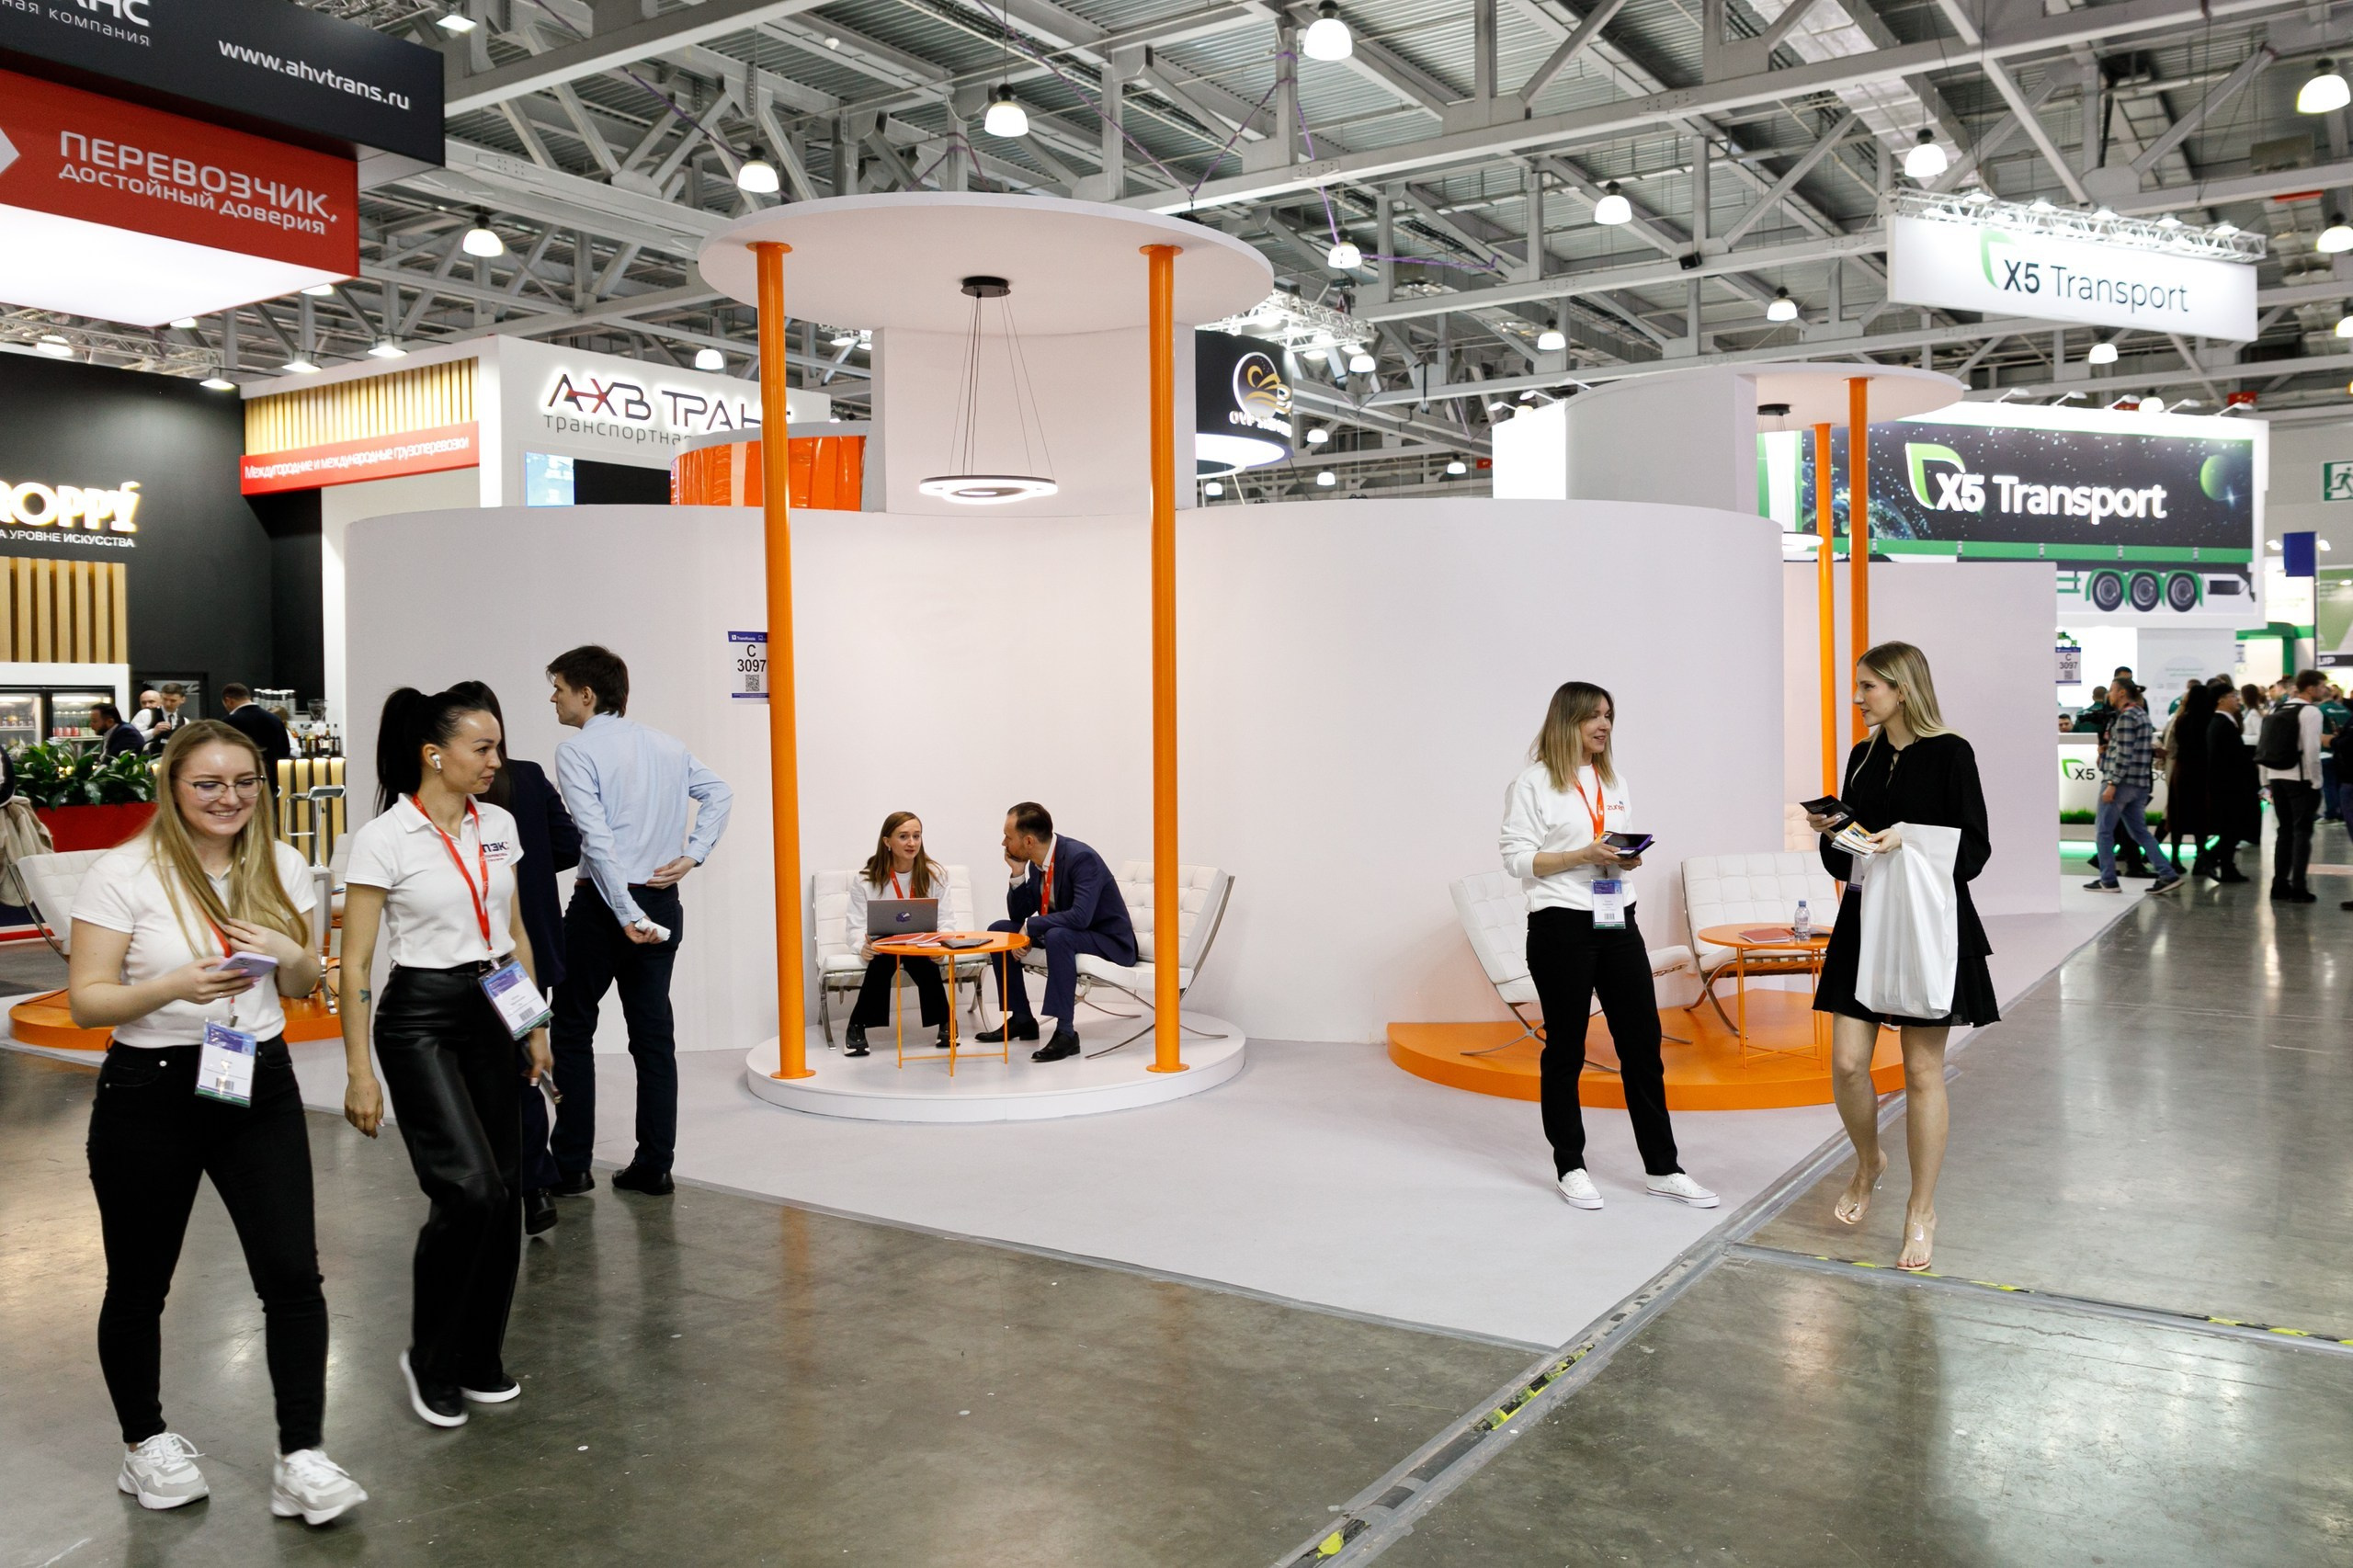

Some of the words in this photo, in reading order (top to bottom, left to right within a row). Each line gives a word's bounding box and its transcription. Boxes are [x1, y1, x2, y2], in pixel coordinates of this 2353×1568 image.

[48, 8, 151, 46] компания
[218, 40, 410, 110] www.ahvtrans.ru
[60, 131, 338, 222] ПЕРЕВОЗЧИК,
[219, 200, 326, 235] доверия
[2004, 259, 2040, 294] X5
[2050, 265, 2188, 313] Transport
[547, 373, 652, 421] АХВ
[661, 390, 791, 430] ТРАН
[314, 459, 320, 469] и
[321, 451, 393, 469] международные
[393, 437, 470, 460] грузоперевозки
[1936, 472, 1986, 513] X5
[1992, 474, 2168, 525] Transport
[9, 529, 62, 542] УРОВНЕ
[63, 533, 136, 548] ИСКУССТВА
[737, 658, 767, 673] 3097
[746, 643, 756, 658] C
[2059, 661, 2079, 670] 3097
[2064, 653, 2073, 662] C
[2075, 768, 2096, 780] X5
